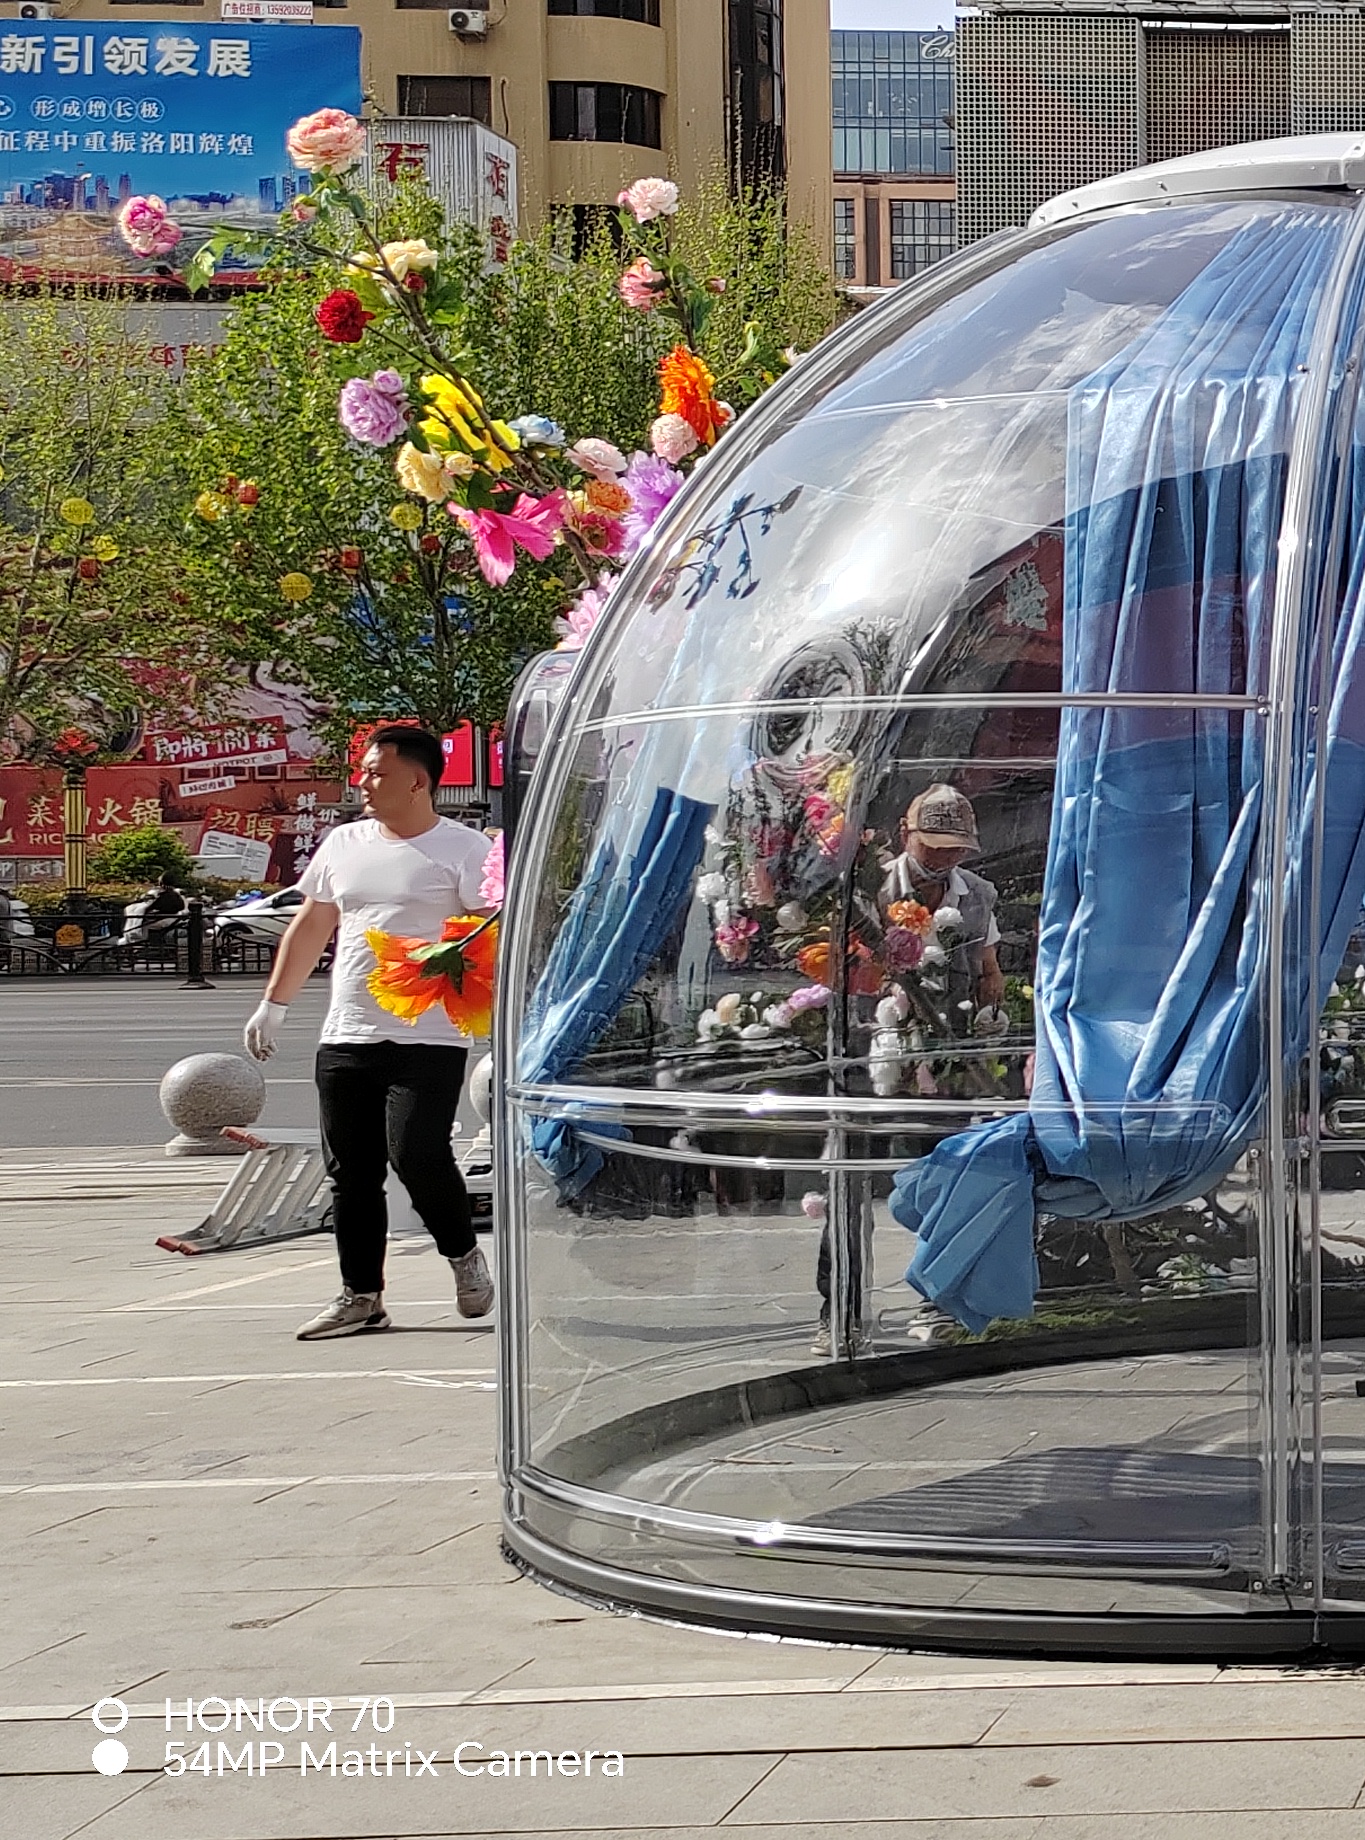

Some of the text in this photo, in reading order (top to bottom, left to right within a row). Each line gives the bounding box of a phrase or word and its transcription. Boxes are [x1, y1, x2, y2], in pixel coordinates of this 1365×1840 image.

[0, 34, 252, 78] 新引领发展
[32, 98, 163, 121] 形成增长极
[26, 795, 164, 828] 菜火锅
